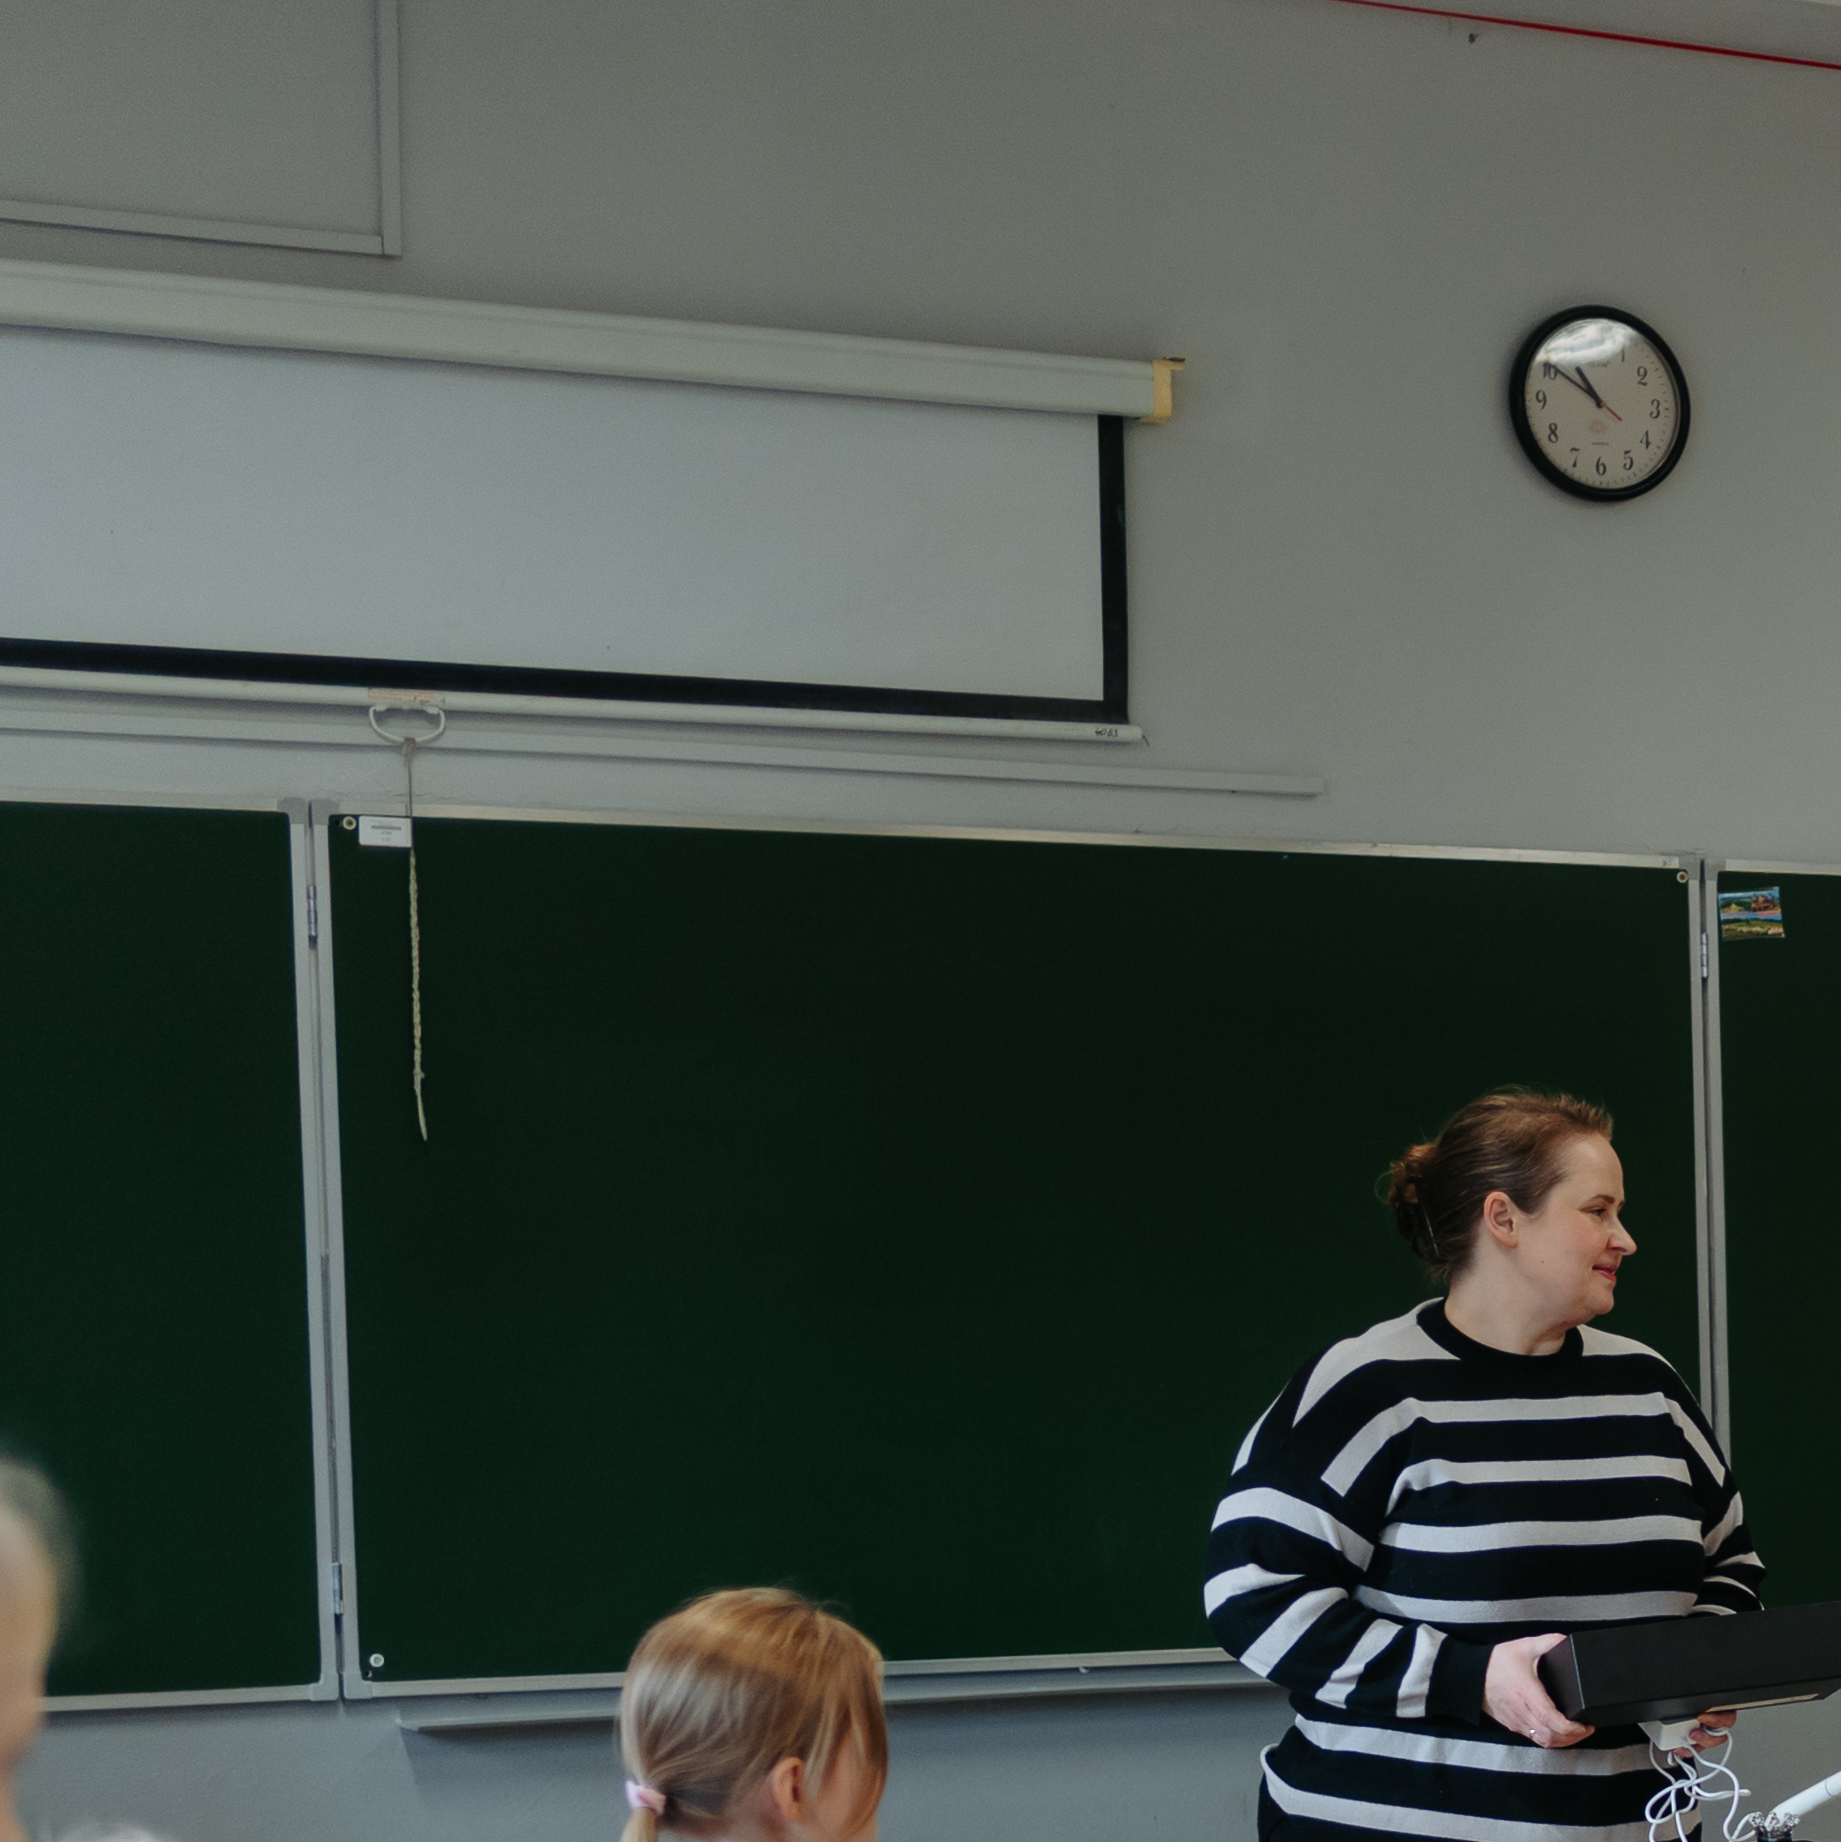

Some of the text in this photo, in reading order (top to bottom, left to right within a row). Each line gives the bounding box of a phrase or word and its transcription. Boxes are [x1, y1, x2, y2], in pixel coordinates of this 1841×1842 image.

[1637, 366, 1648, 386] 2
[1536, 390, 1547, 410] 9
[1650, 399, 1661, 419] 3
[1548, 423, 1558, 443] 8
[1640, 430, 1651, 450] 4
[1570, 447, 1580, 468] 7
[1595, 456, 1607, 476] 6
[1623, 450, 1634, 471] 5
